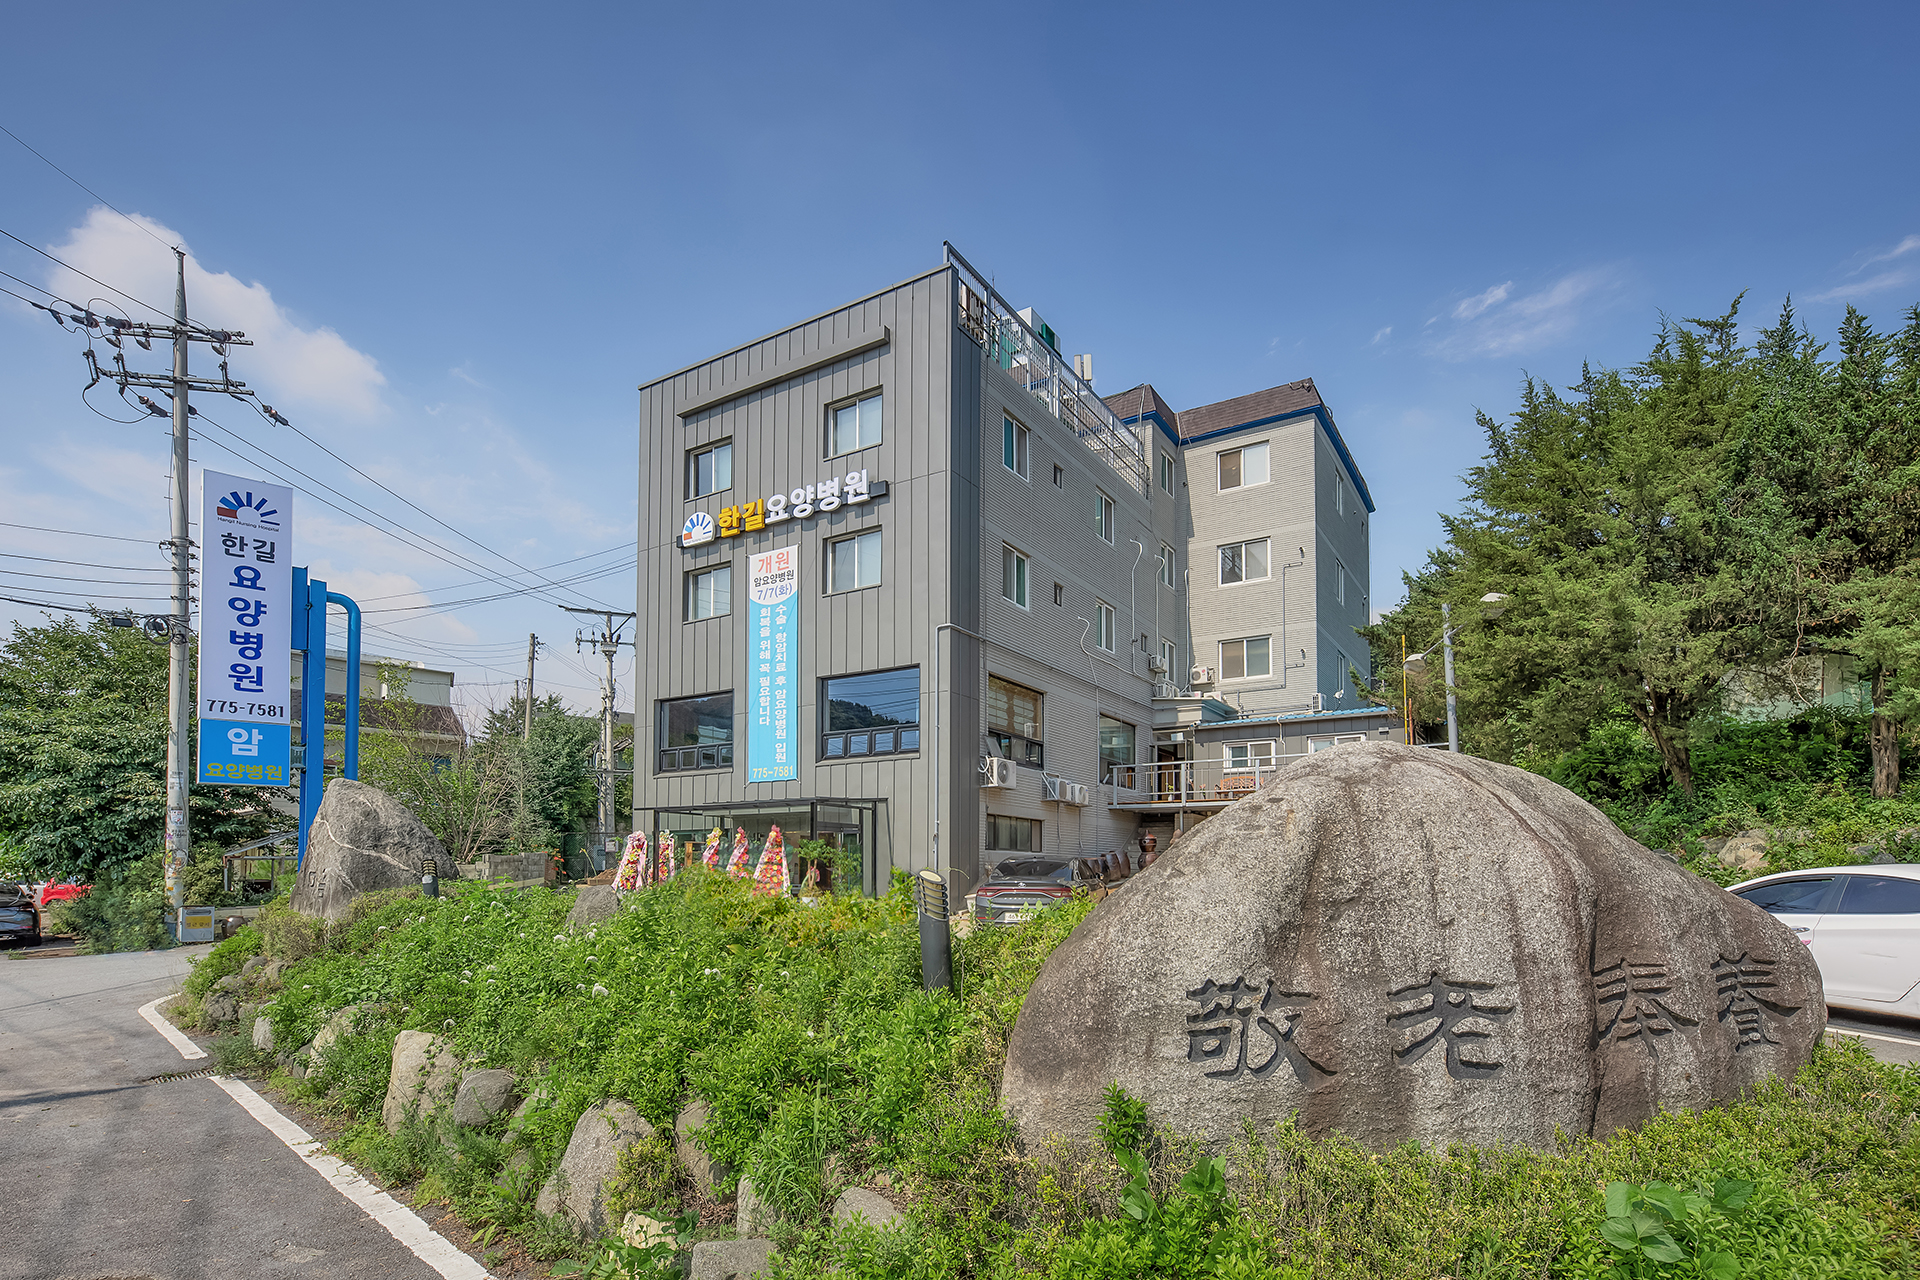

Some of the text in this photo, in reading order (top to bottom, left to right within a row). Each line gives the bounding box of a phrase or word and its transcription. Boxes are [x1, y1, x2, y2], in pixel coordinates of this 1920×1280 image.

[718, 468, 870, 538] 한길요양병원
[236, 520, 257, 529] Nursing
[258, 525, 280, 533] Hospital
[220, 532, 276, 564] 한길
[758, 551, 789, 574] 개원
[753, 569, 795, 588] 암요양병원
[757, 582, 793, 601] 7/7(화)
[227, 565, 268, 693] 요양병원
[759, 606, 771, 637] 회복을
[759, 639, 771, 660] 위해
[774, 675, 787, 686] 후
[206, 699, 285, 718] 775-7581
[758, 676, 771, 726] 필요합니다
[774, 689, 787, 739] 암요양병원
[226, 727, 264, 757] 암
[774, 742, 787, 763] 입원
[204, 762, 283, 781] 요양병원
[752, 765, 794, 779] 775-7581
